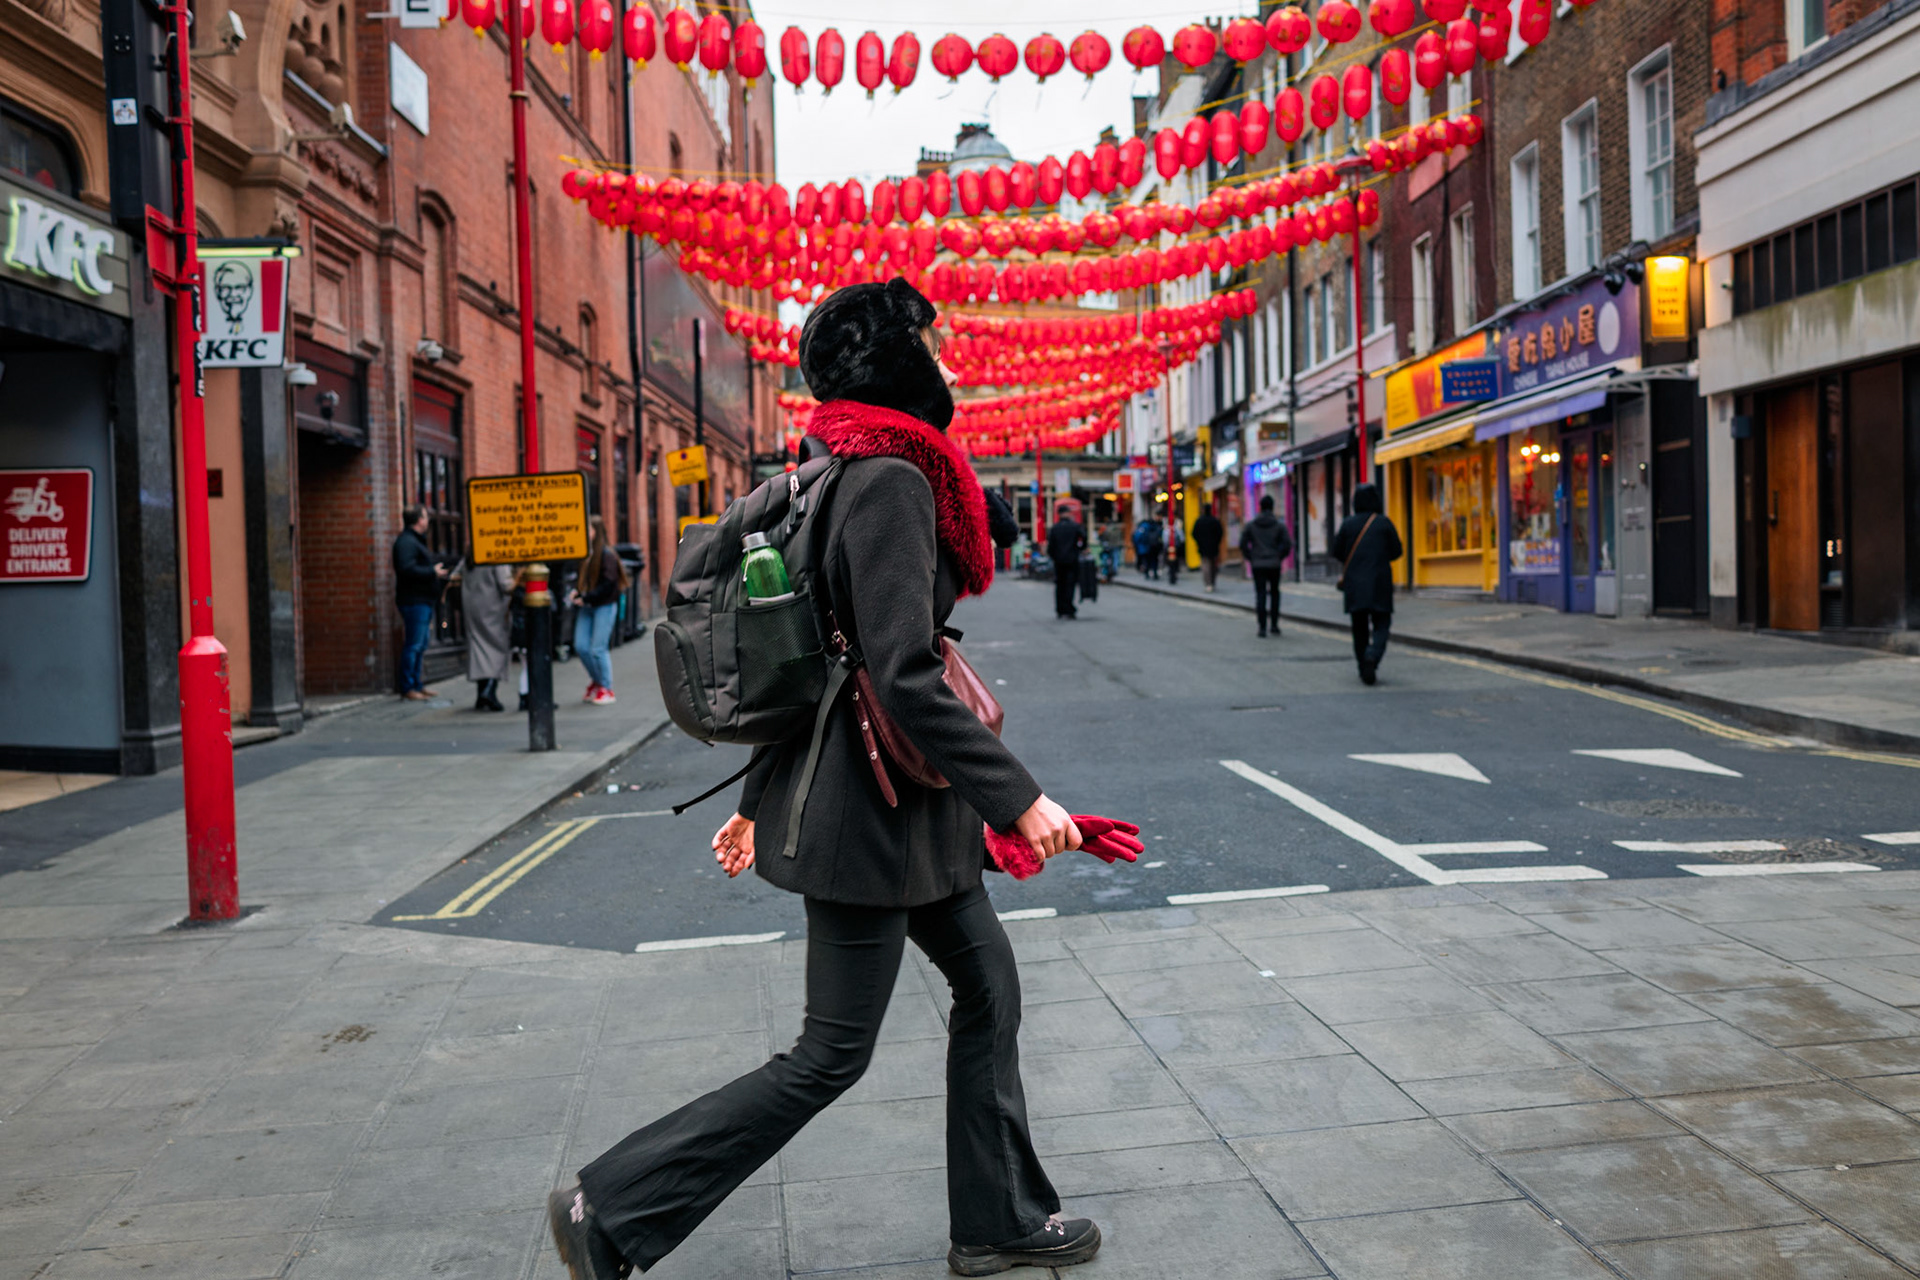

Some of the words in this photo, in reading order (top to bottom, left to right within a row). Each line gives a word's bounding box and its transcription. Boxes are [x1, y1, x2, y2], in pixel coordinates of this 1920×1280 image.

[5, 197, 114, 295] KFC
[203, 338, 268, 360] KFC
[509, 489, 543, 501] EVENT
[475, 504, 518, 515] Saturday
[537, 501, 579, 510] February
[8, 527, 68, 542] DELIVERY
[479, 528, 514, 538] Sunday
[537, 524, 579, 534] February
[10, 542, 68, 557] DRIVER'S
[518, 545, 575, 558] CLOSURES
[6, 558, 71, 573] ENTRANCE
